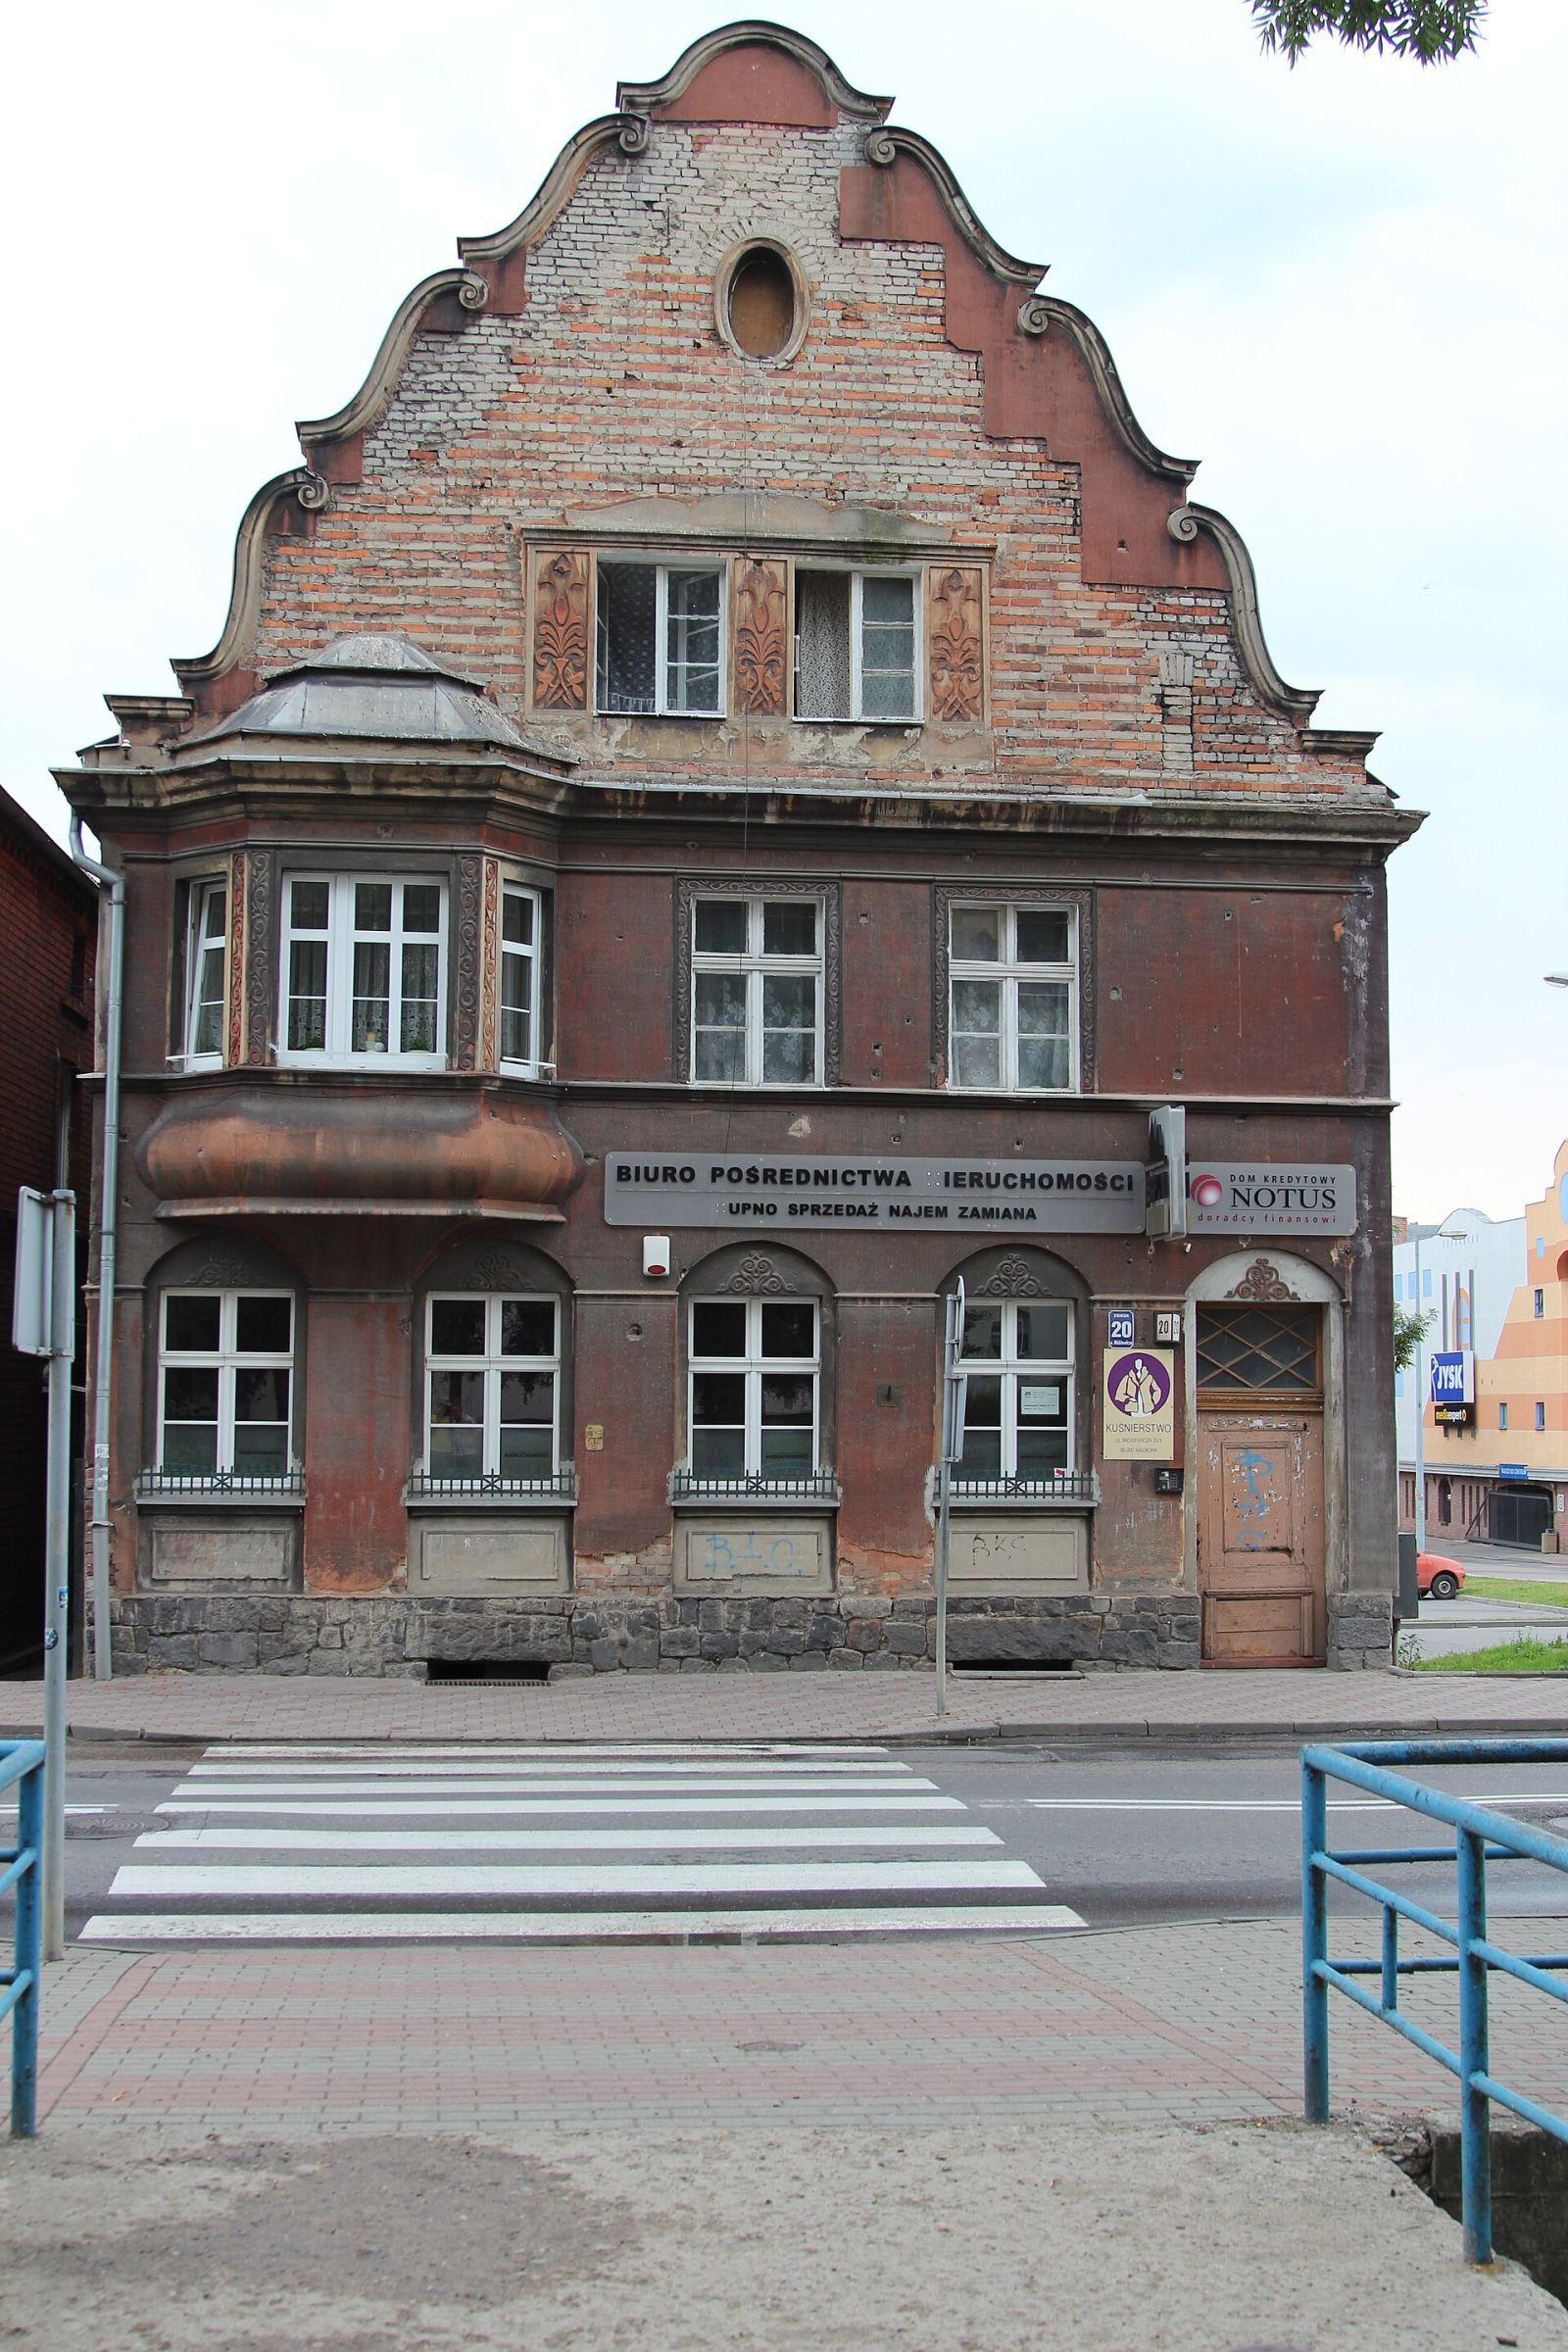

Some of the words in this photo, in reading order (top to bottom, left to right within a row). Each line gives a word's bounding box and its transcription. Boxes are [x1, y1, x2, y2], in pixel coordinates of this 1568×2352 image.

[615, 1165, 697, 1184] BIURO
[710, 1164, 912, 1188] POŚREDNICTWA
[1230, 1174, 1255, 1183] DOM
[1263, 1174, 1336, 1185] KREDYTOWY
[1230, 1187, 1337, 1209] NOTUS
[787, 1201, 879, 1218] SPRZEDAŻ
[889, 1204, 949, 1219] NAJEM
[957, 1205, 1037, 1221] ZAMIANA
[1197, 1211, 1255, 1224] doradcy
[1264, 1212, 1336, 1224] finansowi
[1111, 1320, 1132, 1339] 20
[1158, 1320, 1169, 1335] 20
[1437, 1364, 1463, 1390] JYSK
[1105, 1422, 1172, 1433] KUŚNIERSTWO
